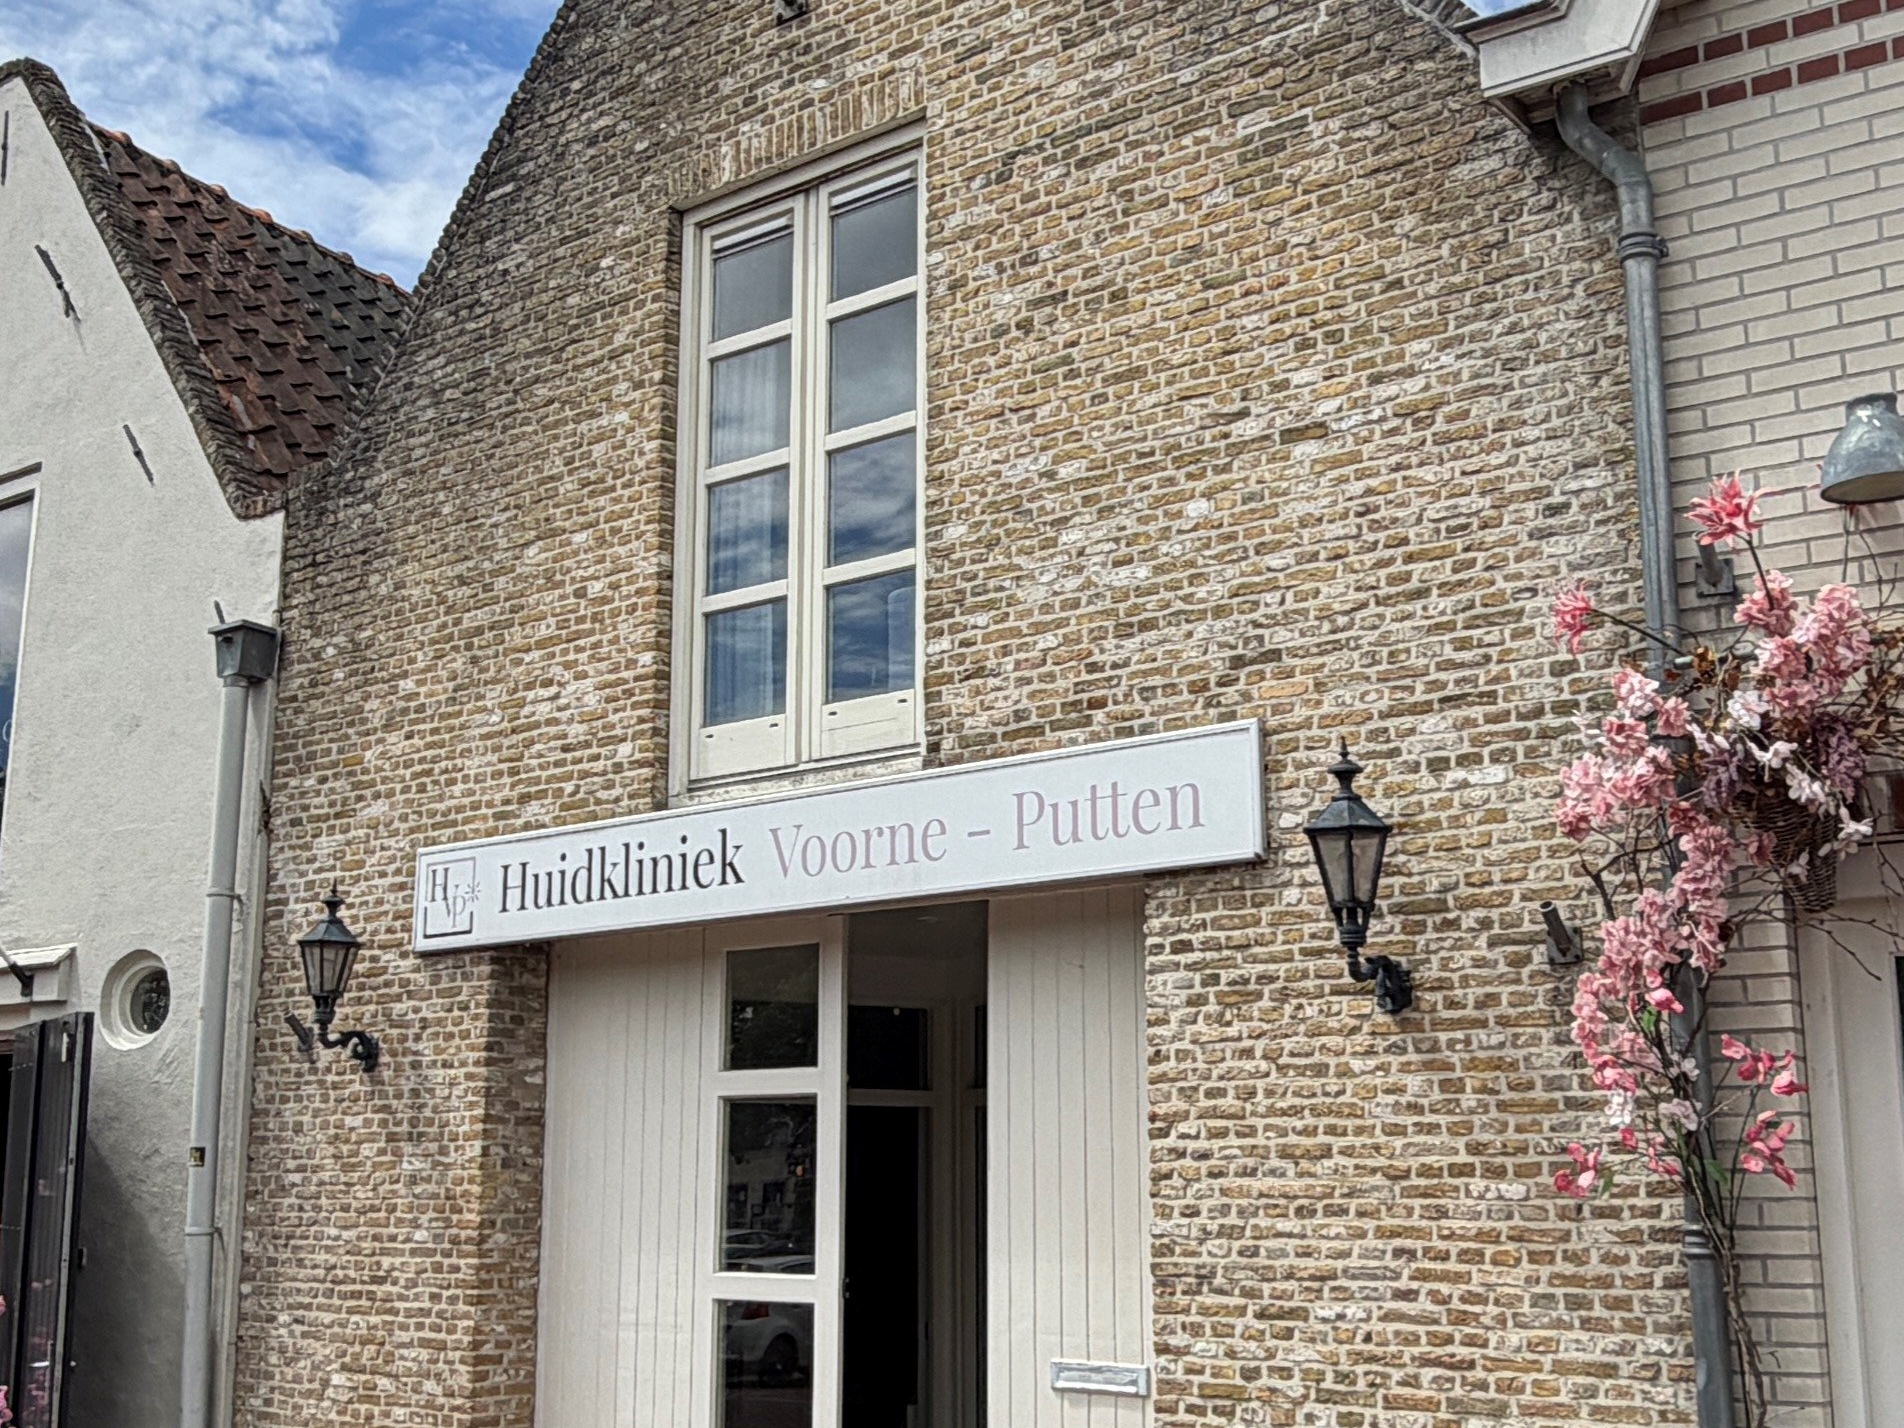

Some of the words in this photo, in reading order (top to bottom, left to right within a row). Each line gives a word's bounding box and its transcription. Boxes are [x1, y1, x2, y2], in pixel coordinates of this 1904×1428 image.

[498, 827, 745, 914] Huidkliniek
[769, 814, 947, 881] Voorne
[1012, 780, 1204, 852] Putten
